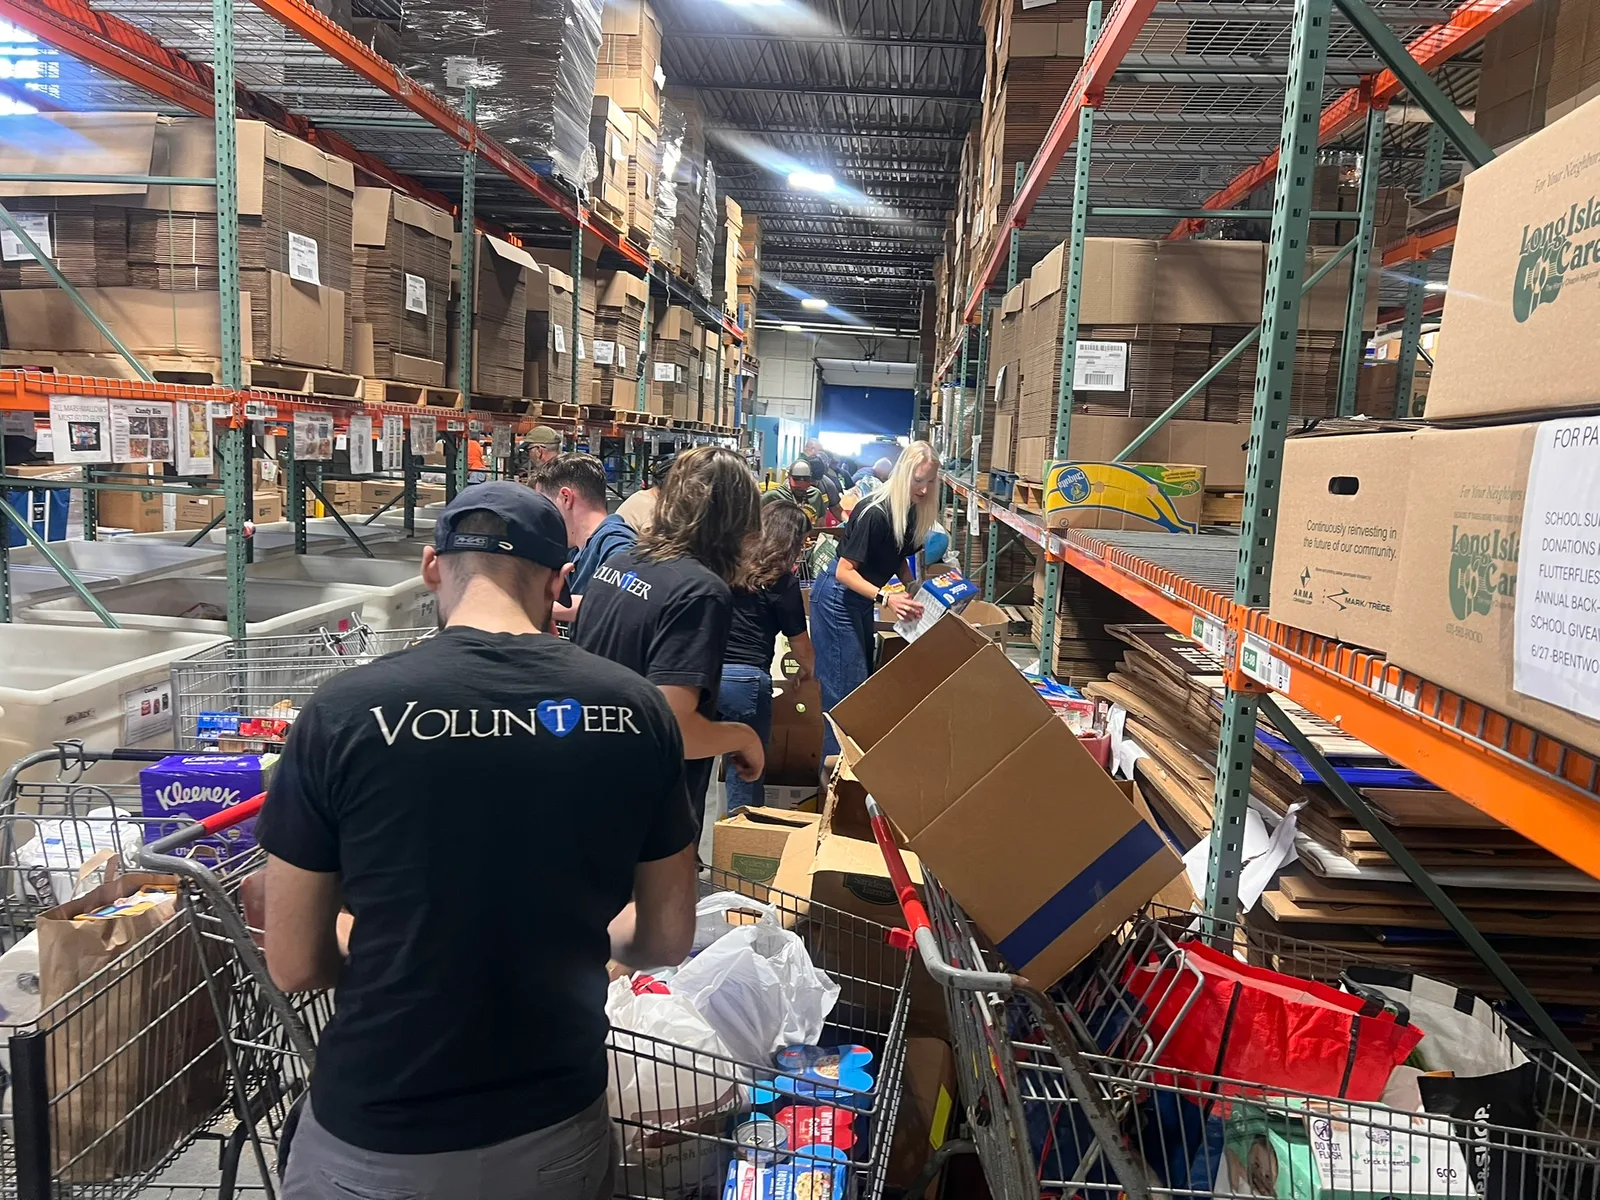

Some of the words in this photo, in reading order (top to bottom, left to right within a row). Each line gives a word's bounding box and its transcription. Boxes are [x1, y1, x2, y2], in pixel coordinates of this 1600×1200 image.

[1519, 211, 1568, 262] Long
[135, 407, 151, 415] Candy
[152, 407, 162, 415] Bin
[1554, 428, 1581, 449] FOR
[1545, 511, 1582, 527] SCHOOL
[1584, 512, 1600, 528] SU
[1306, 519, 1347, 537] Continuously
[1347, 523, 1389, 542] reinvesting
[1389, 526, 1398, 540] in
[1303, 536, 1314, 548] the
[1313, 537, 1332, 551] future
[1332, 539, 1341, 551] of
[1340, 543, 1354, 554] our
[1354, 545, 1397, 562] community.
[1450, 524, 1491, 567] Long
[1542, 538, 1596, 556] DONATIONS
[1539, 563, 1600, 585] FLUTTERFLIES
[1293, 588, 1314, 600] ARMA
[1535, 589, 1569, 609] ANNUAL
[1530, 614, 1567, 635] SCHOOL
[369, 699, 642, 747] VOLUNTEER
[155, 781, 241, 812] Kleenex
[1314, 1141, 1326, 1150] DO
[1363, 1157, 1382, 1165] thck
[1436, 1167, 1457, 1178] 600
